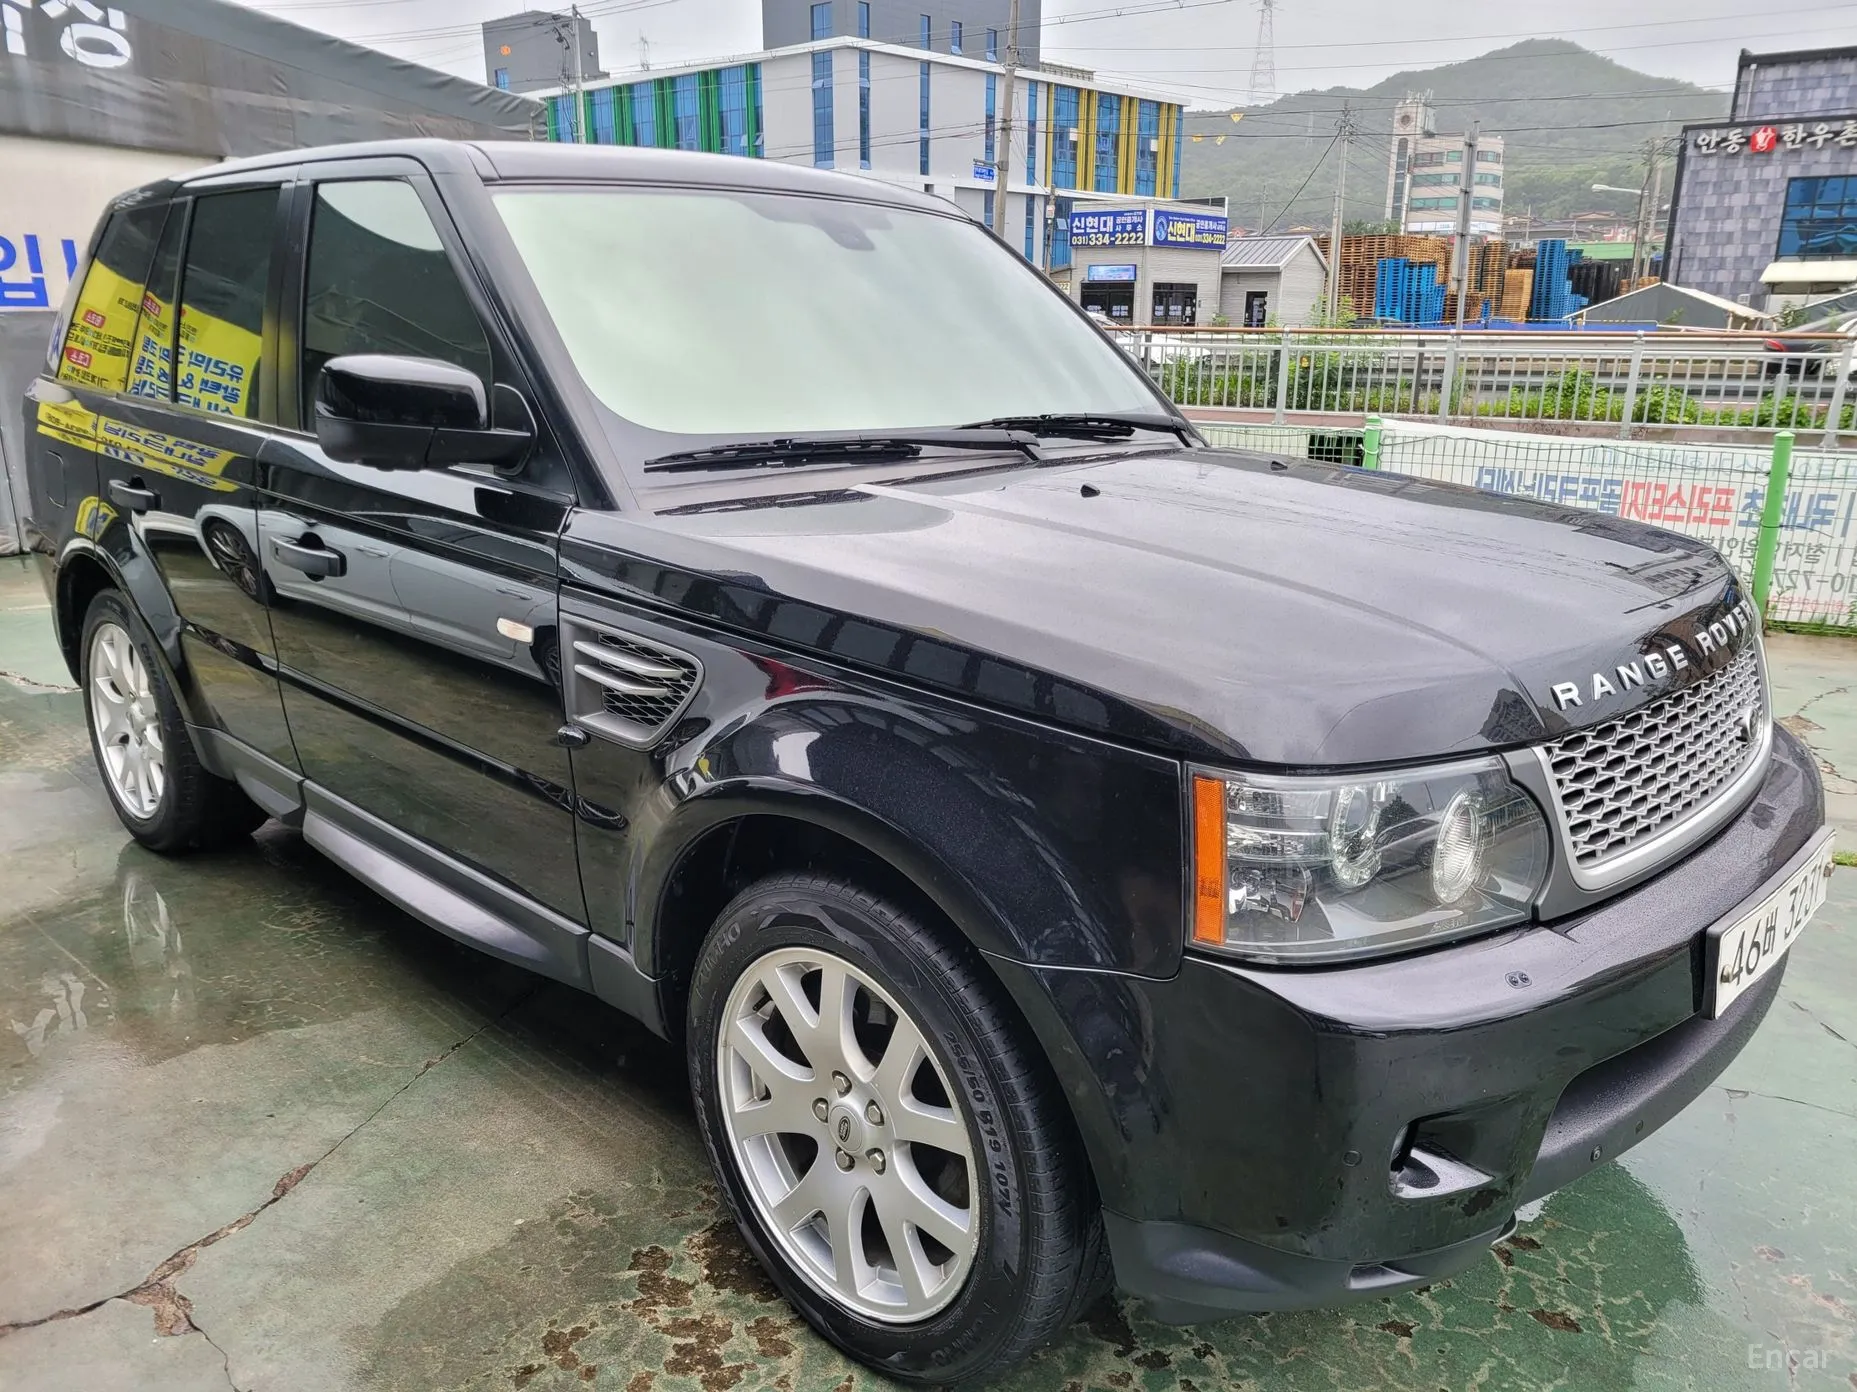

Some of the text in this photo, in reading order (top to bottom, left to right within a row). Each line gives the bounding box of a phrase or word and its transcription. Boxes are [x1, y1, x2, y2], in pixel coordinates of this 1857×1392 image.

[1697, 120, 1857, 154] 안동 한우촌
[1072, 216, 1143, 233] 신현대 공인중개사
[1168, 221, 1195, 242] 신현대
[1551, 599, 1754, 711] RANGE ROVER
[1732, 905, 1779, 985] 46버
